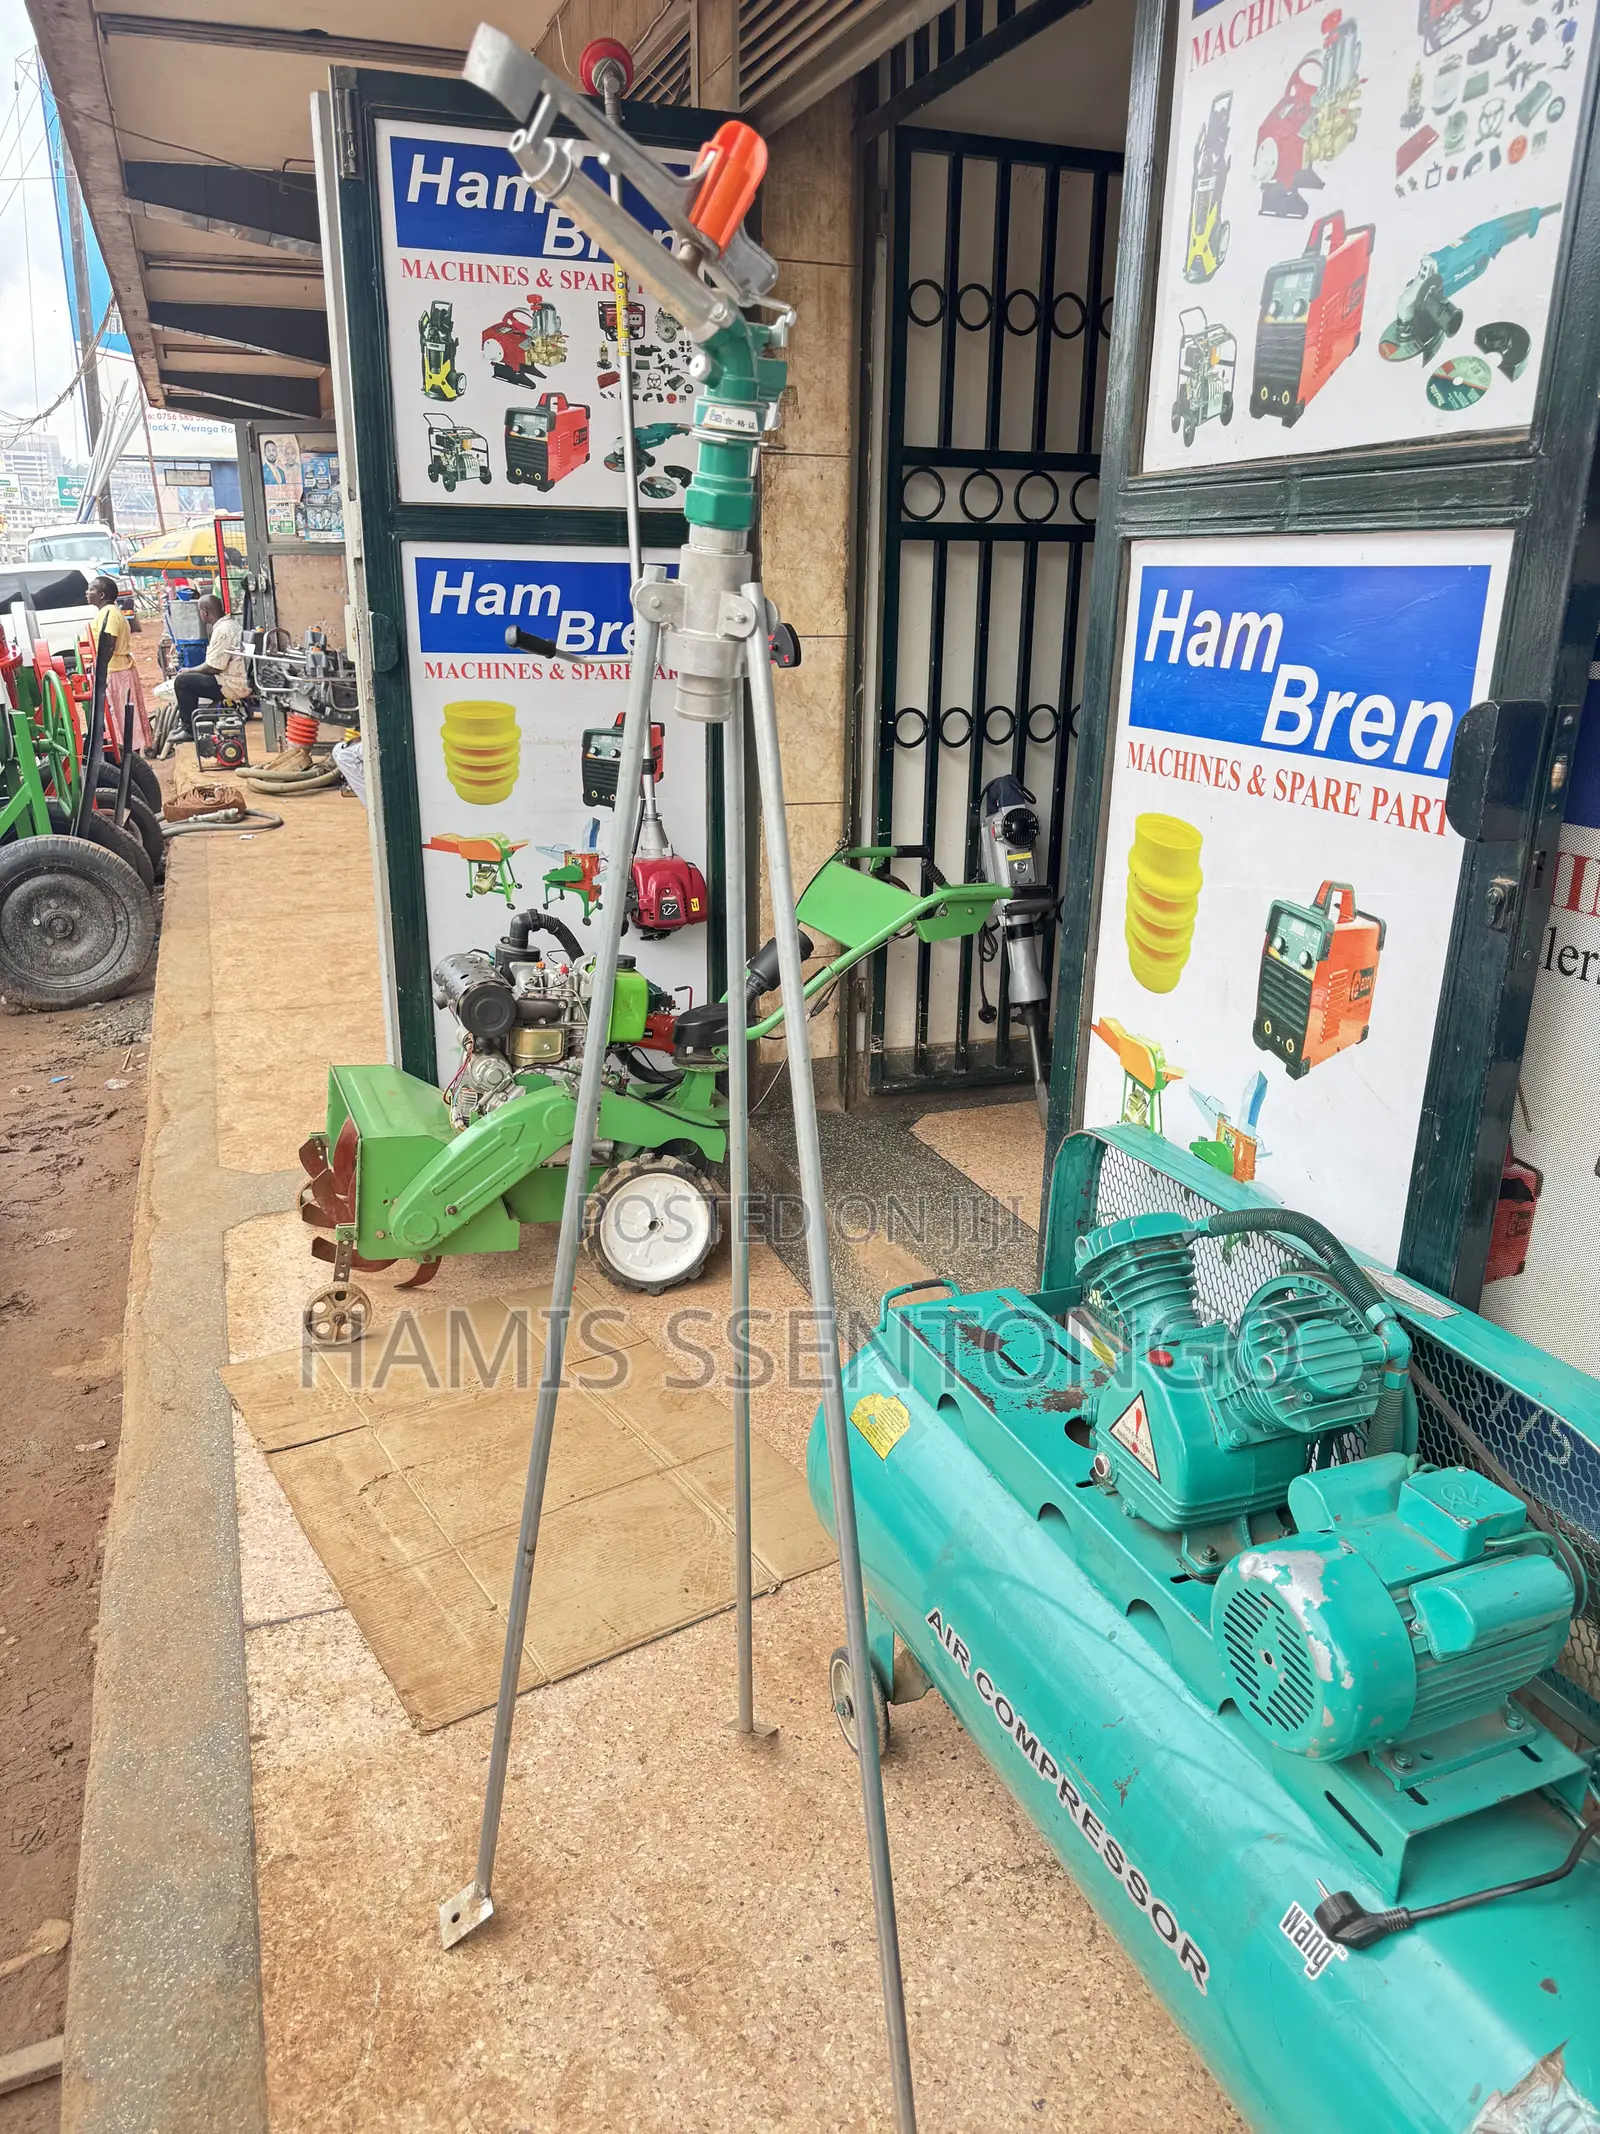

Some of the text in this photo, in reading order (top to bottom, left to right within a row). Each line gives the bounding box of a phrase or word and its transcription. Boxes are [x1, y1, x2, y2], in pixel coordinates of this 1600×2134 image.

[400, 258, 529, 288] MACHINES
[536, 268, 553, 288] &
[560, 269, 630, 293] SPAR
[149, 423, 169, 432] lock
[221, 426, 234, 434] Ro
[429, 570, 561, 617] Ham
[1144, 588, 1284, 674] Ham
[423, 661, 543, 681] MACHINES
[549, 663, 566, 681] &
[1260, 663, 1454, 772] Bren
[1126, 741, 1242, 792] MACHINES
[1246, 763, 1267, 798] &
[1272, 768, 1362, 818] SPARE
[926, 1609, 1208, 1990] AIR COMPRESSOR
[1281, 1904, 1336, 1977] wang
